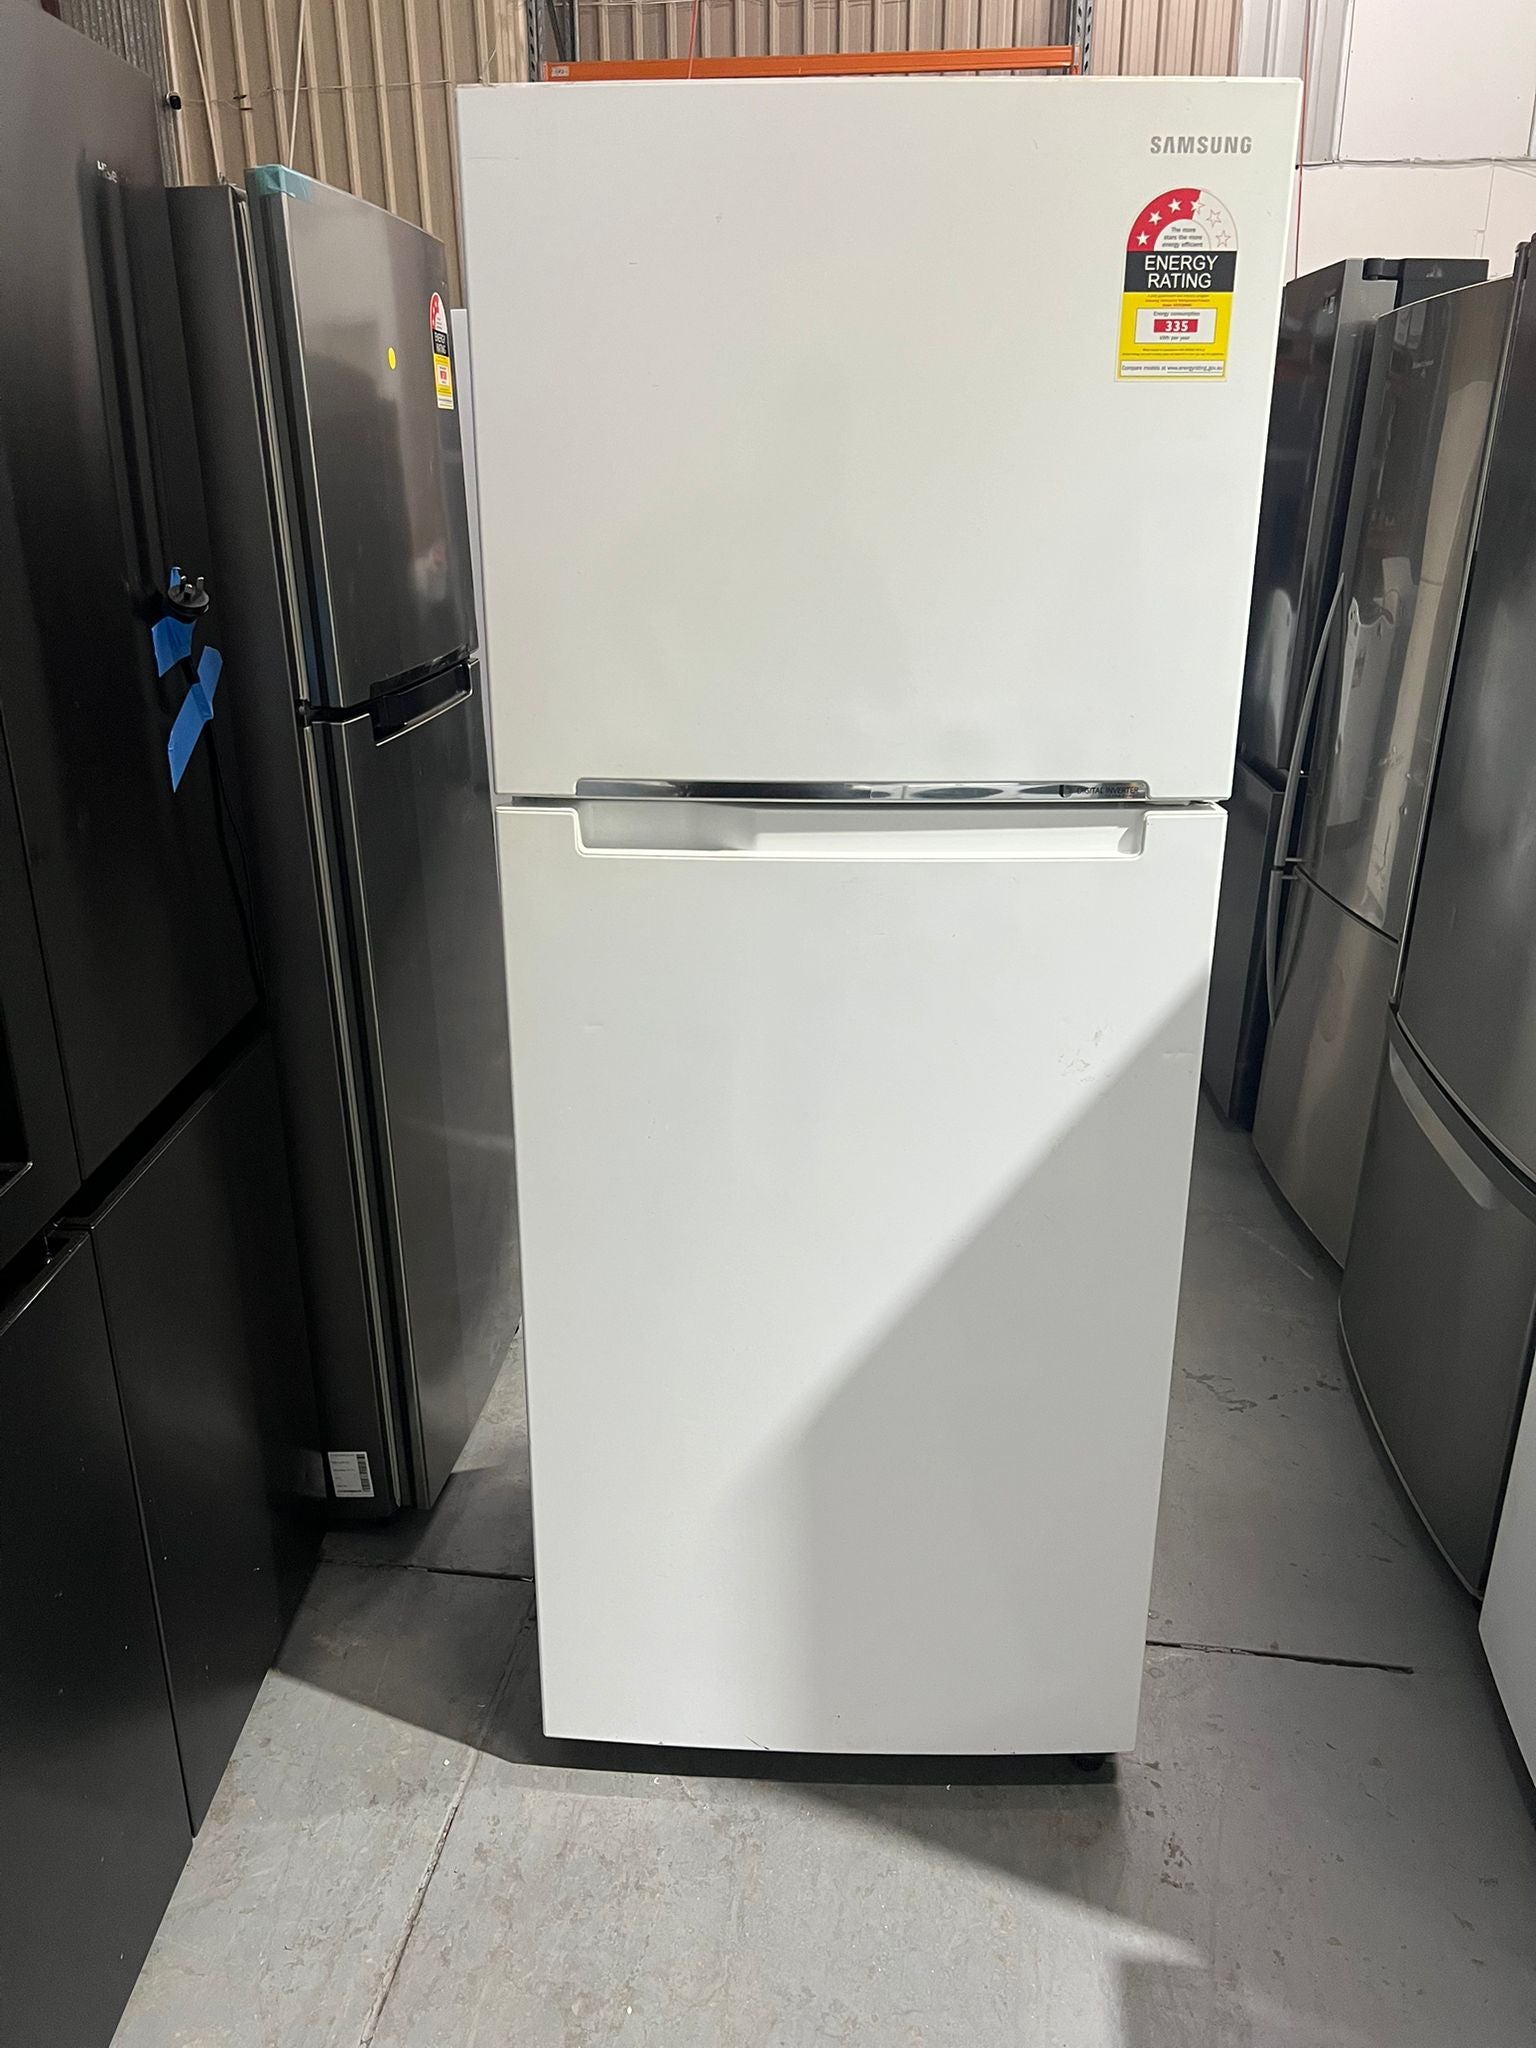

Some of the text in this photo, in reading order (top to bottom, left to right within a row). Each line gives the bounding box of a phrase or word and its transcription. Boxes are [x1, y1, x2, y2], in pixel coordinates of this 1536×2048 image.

[1150, 136, 1252, 154] SAMSUNG
[1145, 255, 1219, 271] ENERGY
[1147, 272, 1212, 289] RATING
[1165, 320, 1189, 332] 335
